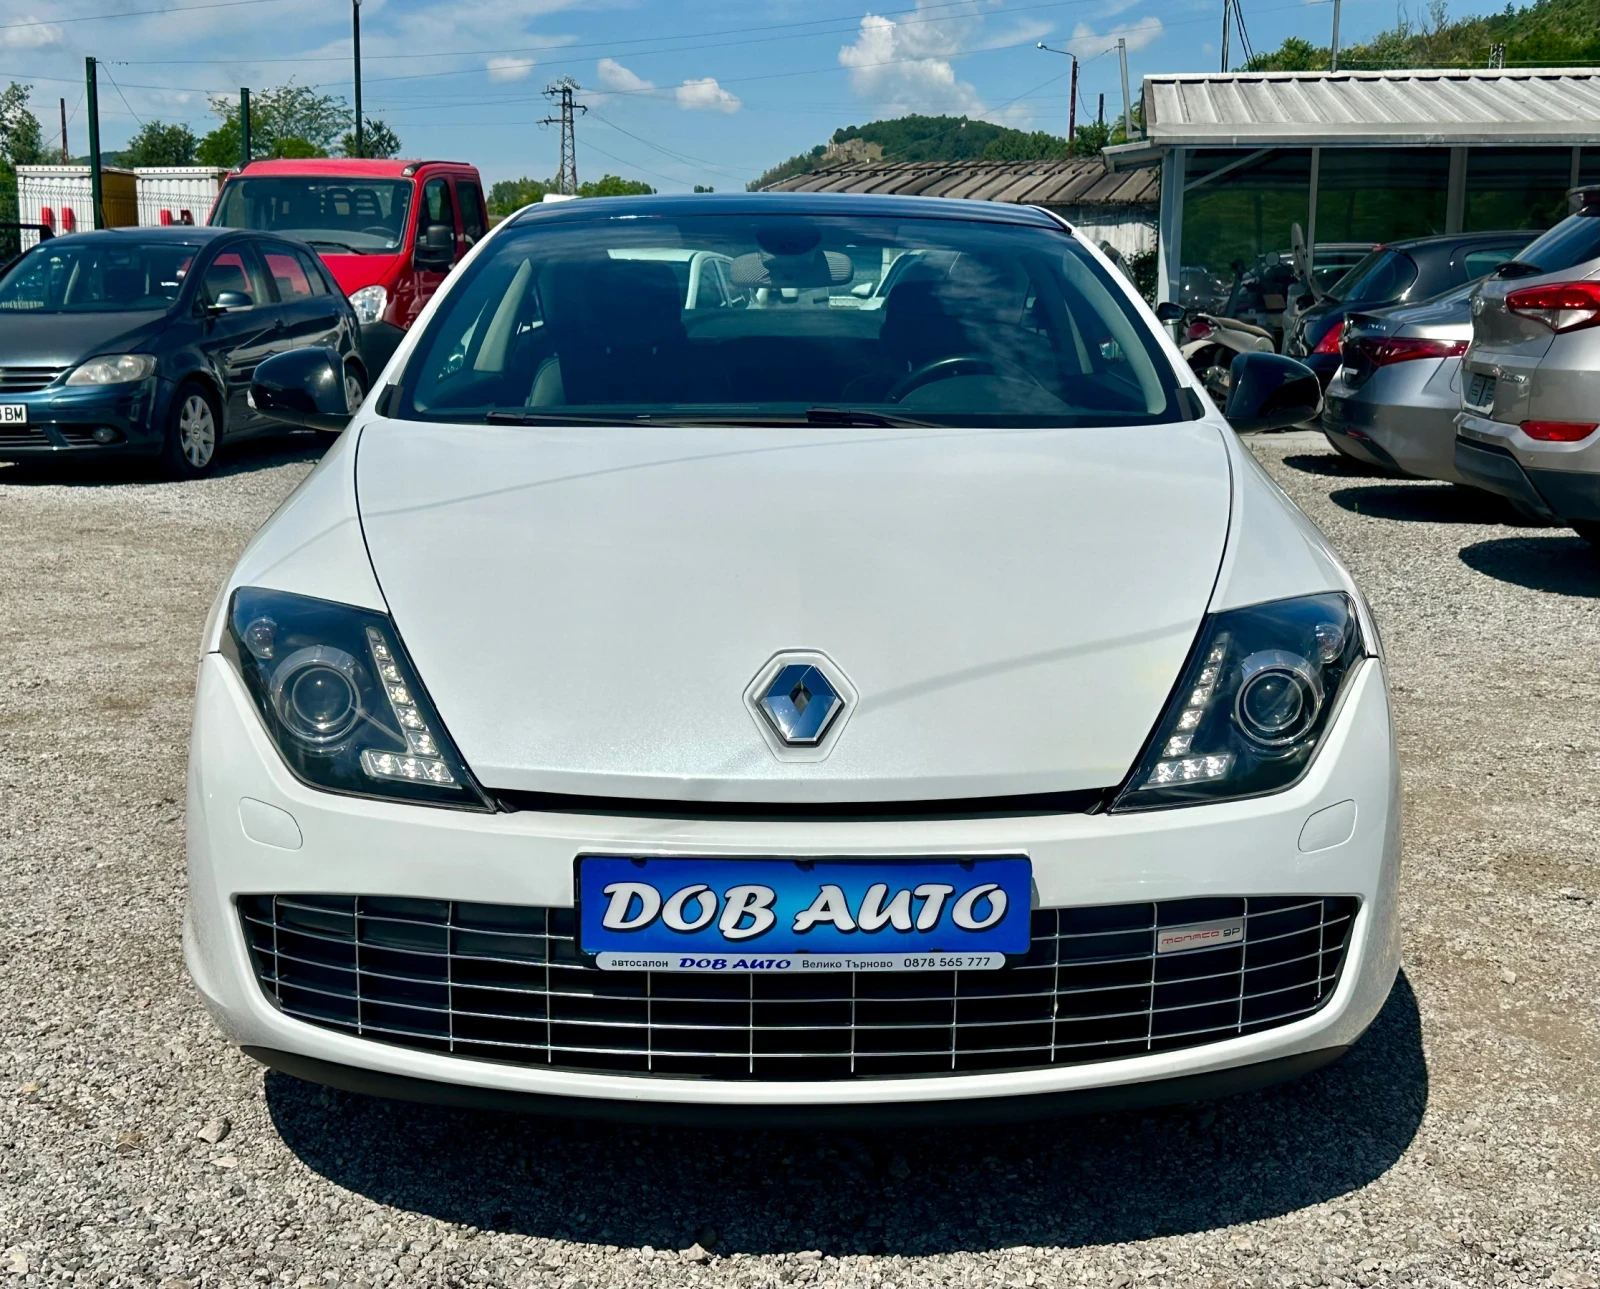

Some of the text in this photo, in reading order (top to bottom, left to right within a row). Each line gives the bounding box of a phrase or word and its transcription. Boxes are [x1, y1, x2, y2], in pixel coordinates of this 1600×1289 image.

[601, 882, 1008, 942] DOB AUTO
[611, 957, 991, 970] автосалон DOB AUTO Велико Търново 0878 565 777
